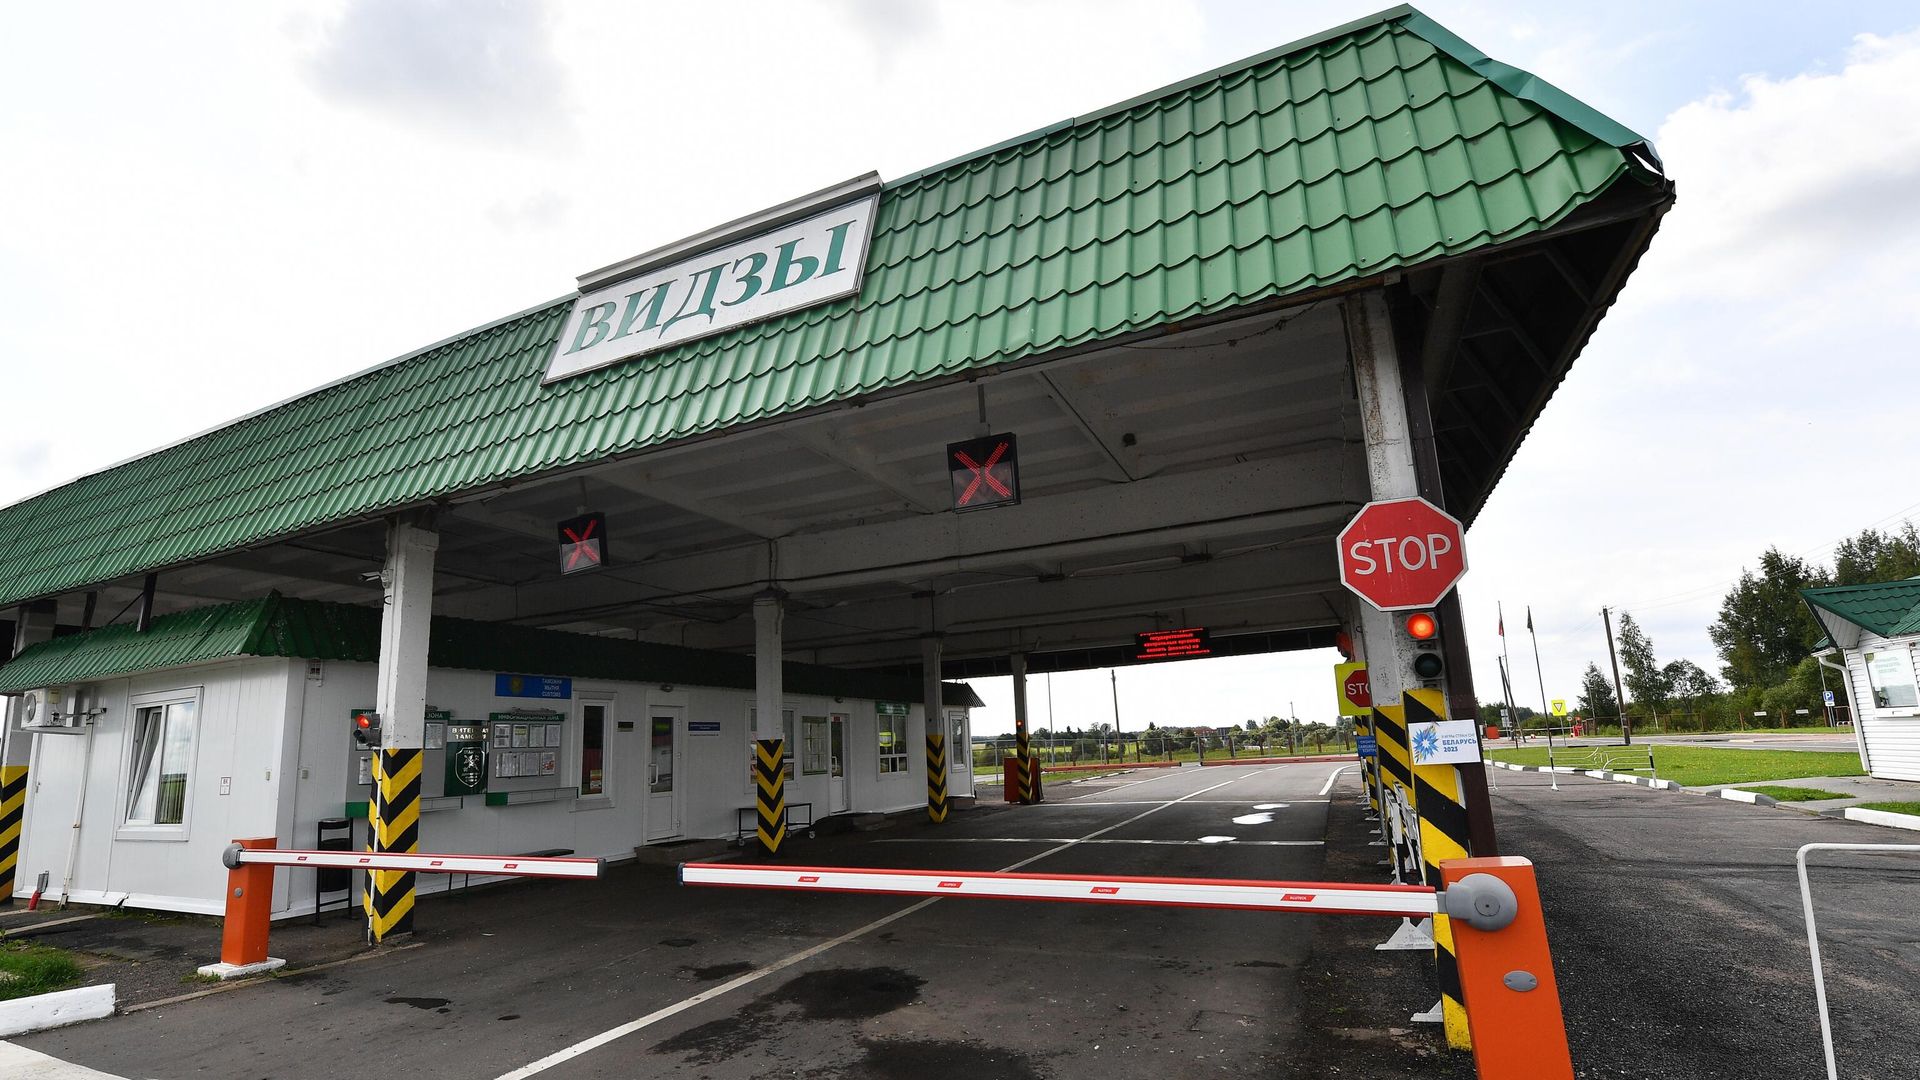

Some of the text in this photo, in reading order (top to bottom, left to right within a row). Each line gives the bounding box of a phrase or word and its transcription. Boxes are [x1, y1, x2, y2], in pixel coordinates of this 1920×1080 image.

[563, 219, 856, 356] ВИДЗЫ
[1350, 533, 1452, 575] STOP
[1442, 738, 1477, 746] БЕЛАРУСЬ
